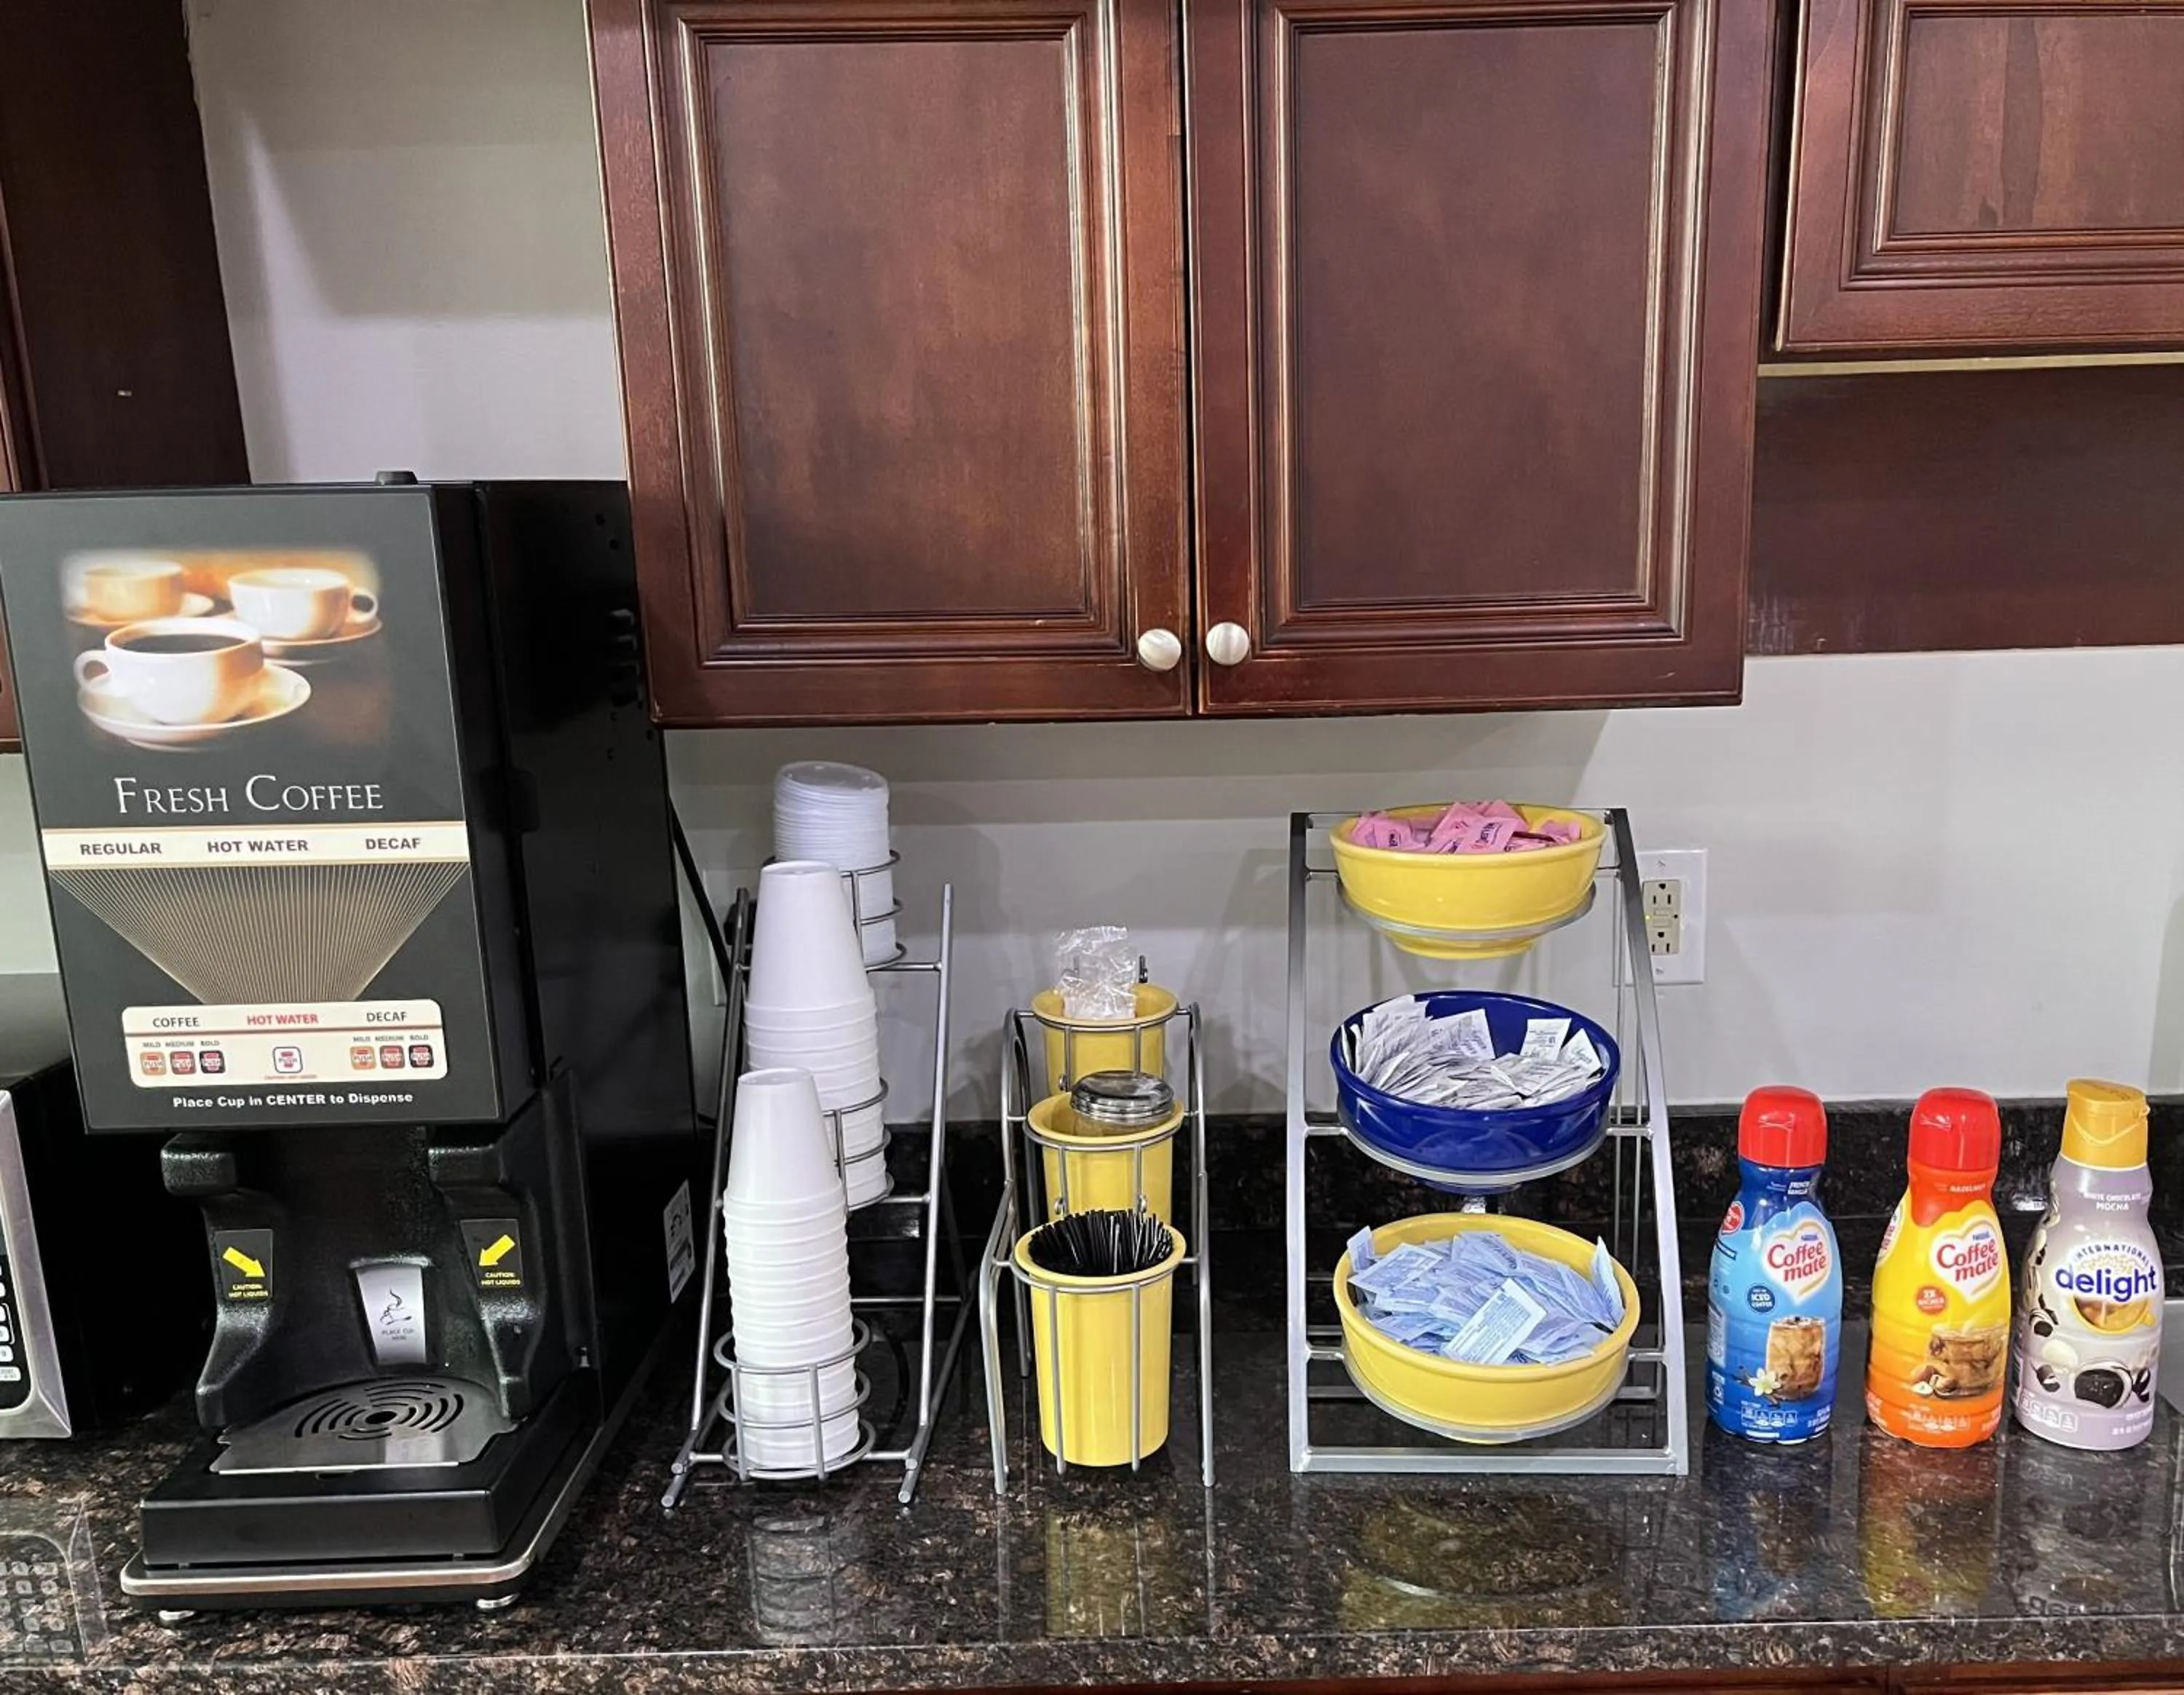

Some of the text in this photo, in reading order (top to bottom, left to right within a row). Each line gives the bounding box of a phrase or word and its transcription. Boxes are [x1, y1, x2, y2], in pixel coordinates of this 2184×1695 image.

[114, 774, 384, 814] FRESH COFFEE
[79, 841, 163, 856] REGULAR
[207, 839, 309, 854] HOT WATER
[365, 837, 422, 850] DECAF
[152, 1016, 200, 1028] COFFEE
[246, 1013, 319, 1026] HOT WATER
[366, 1011, 408, 1022] DECAF
[173, 1097, 213, 1107] Place
[217, 1096, 245, 1108] Cup
[266, 1094, 326, 1106] CENTER
[330, 1094, 344, 1105] to
[348, 1093, 414, 1105] Dispense
[2096, 1201, 2129, 1211] MOCHA
[1767, 1241, 1824, 1269] Coffee
[1936, 1238, 1995, 1269] Coffee
[2074, 1244, 2151, 1266] INTERNATIONAL
[1784, 1255, 1828, 1282] mate
[1955, 1252, 1999, 1282] mate
[2055, 1265, 2157, 1303] delight
